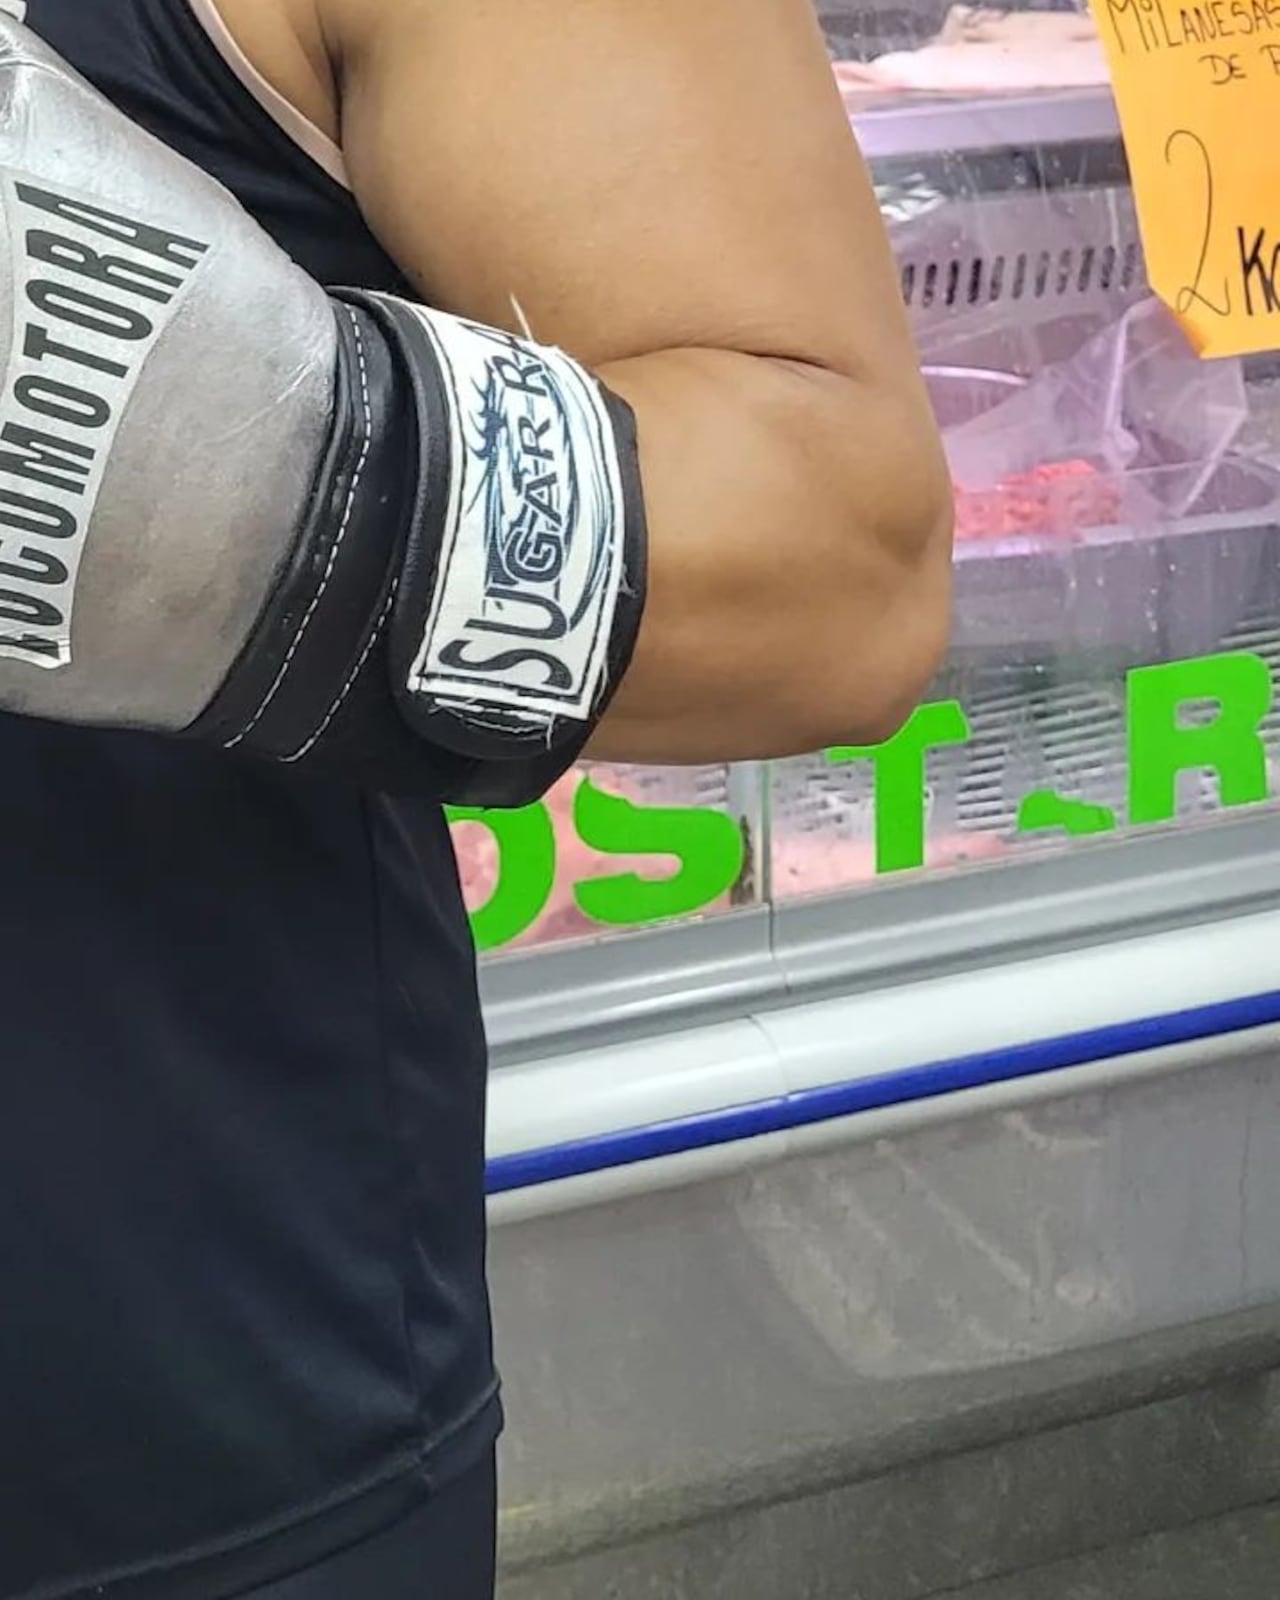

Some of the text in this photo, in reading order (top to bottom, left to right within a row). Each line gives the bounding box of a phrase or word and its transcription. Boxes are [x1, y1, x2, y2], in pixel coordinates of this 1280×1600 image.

[1197, 53, 1247, 87] DE
[1165, 129, 1231, 317] 2
[438, 414, 574, 691] SUGAR
